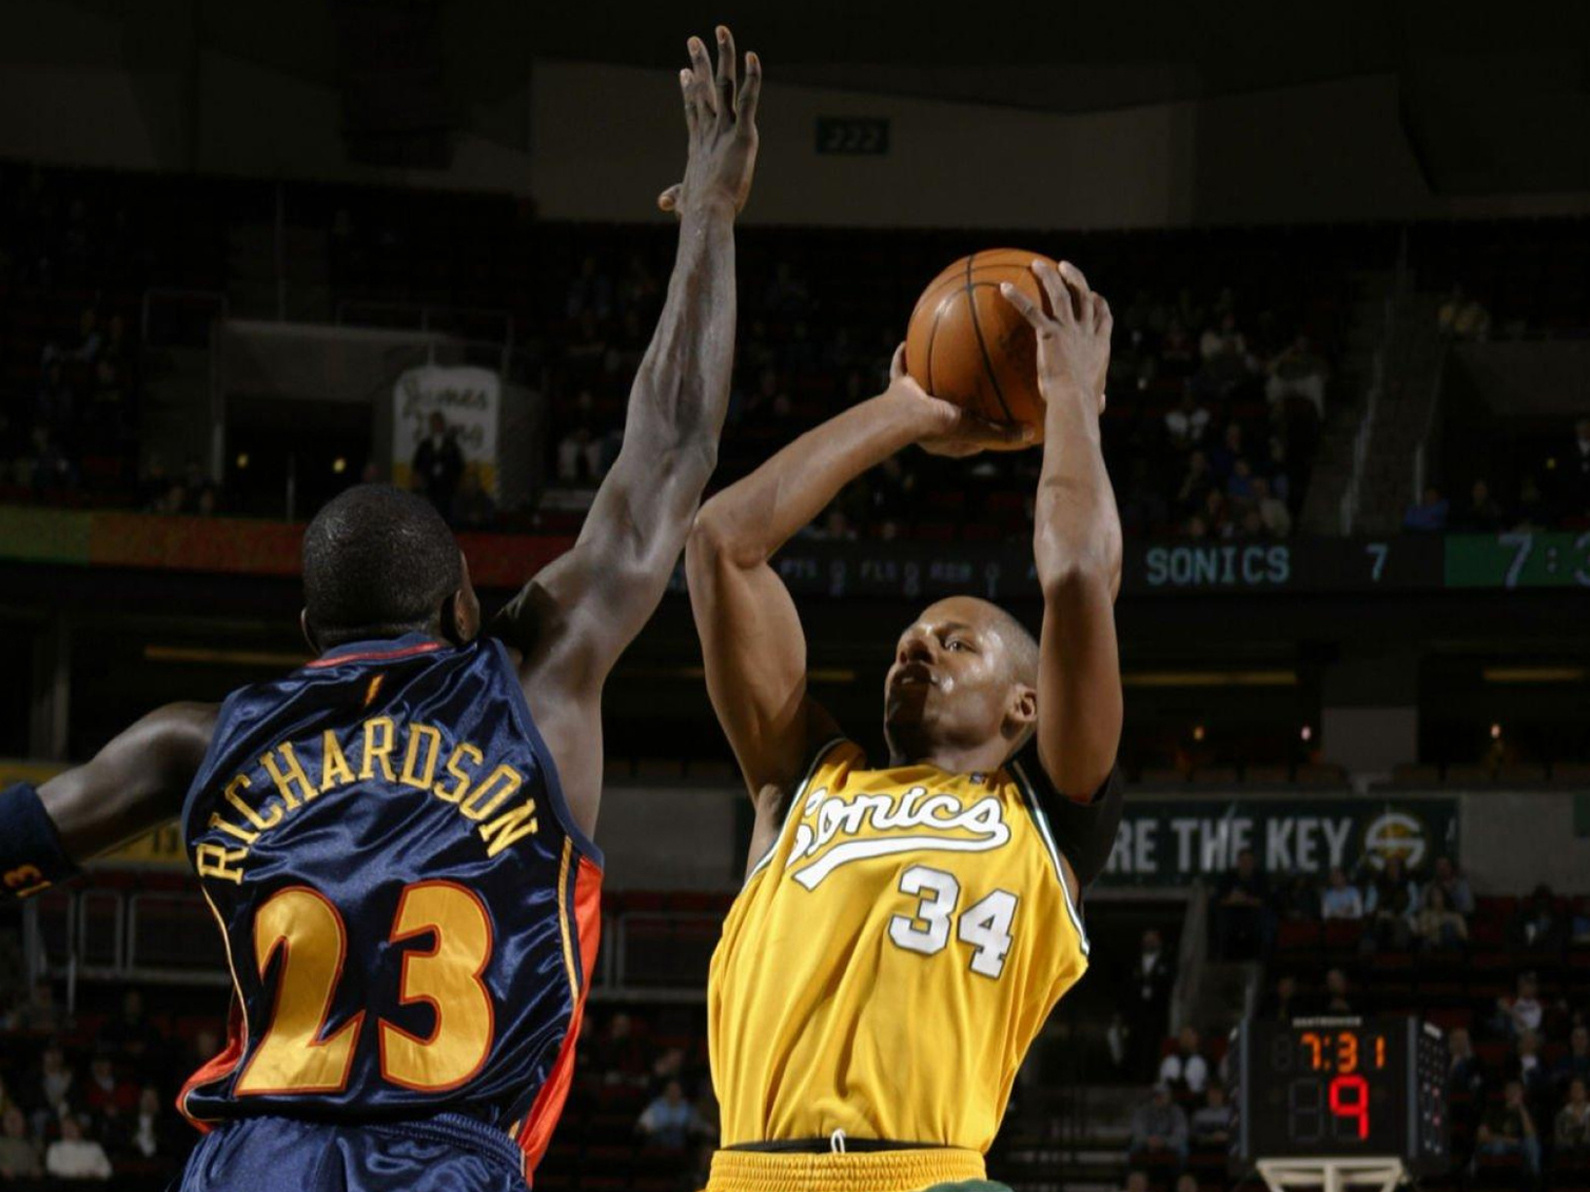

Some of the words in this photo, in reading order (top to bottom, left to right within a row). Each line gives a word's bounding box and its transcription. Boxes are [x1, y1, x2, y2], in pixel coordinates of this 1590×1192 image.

[1146, 546, 1290, 585] SONICS
[1366, 544, 1388, 581] 7
[195, 714, 538, 885] RICHARDSON
[1170, 818, 1252, 873] THE
[1266, 818, 1352, 873] KEY
[888, 865, 1018, 980] 34
[233, 879, 495, 1097] 23
[1329, 1075, 1369, 1139] 9
